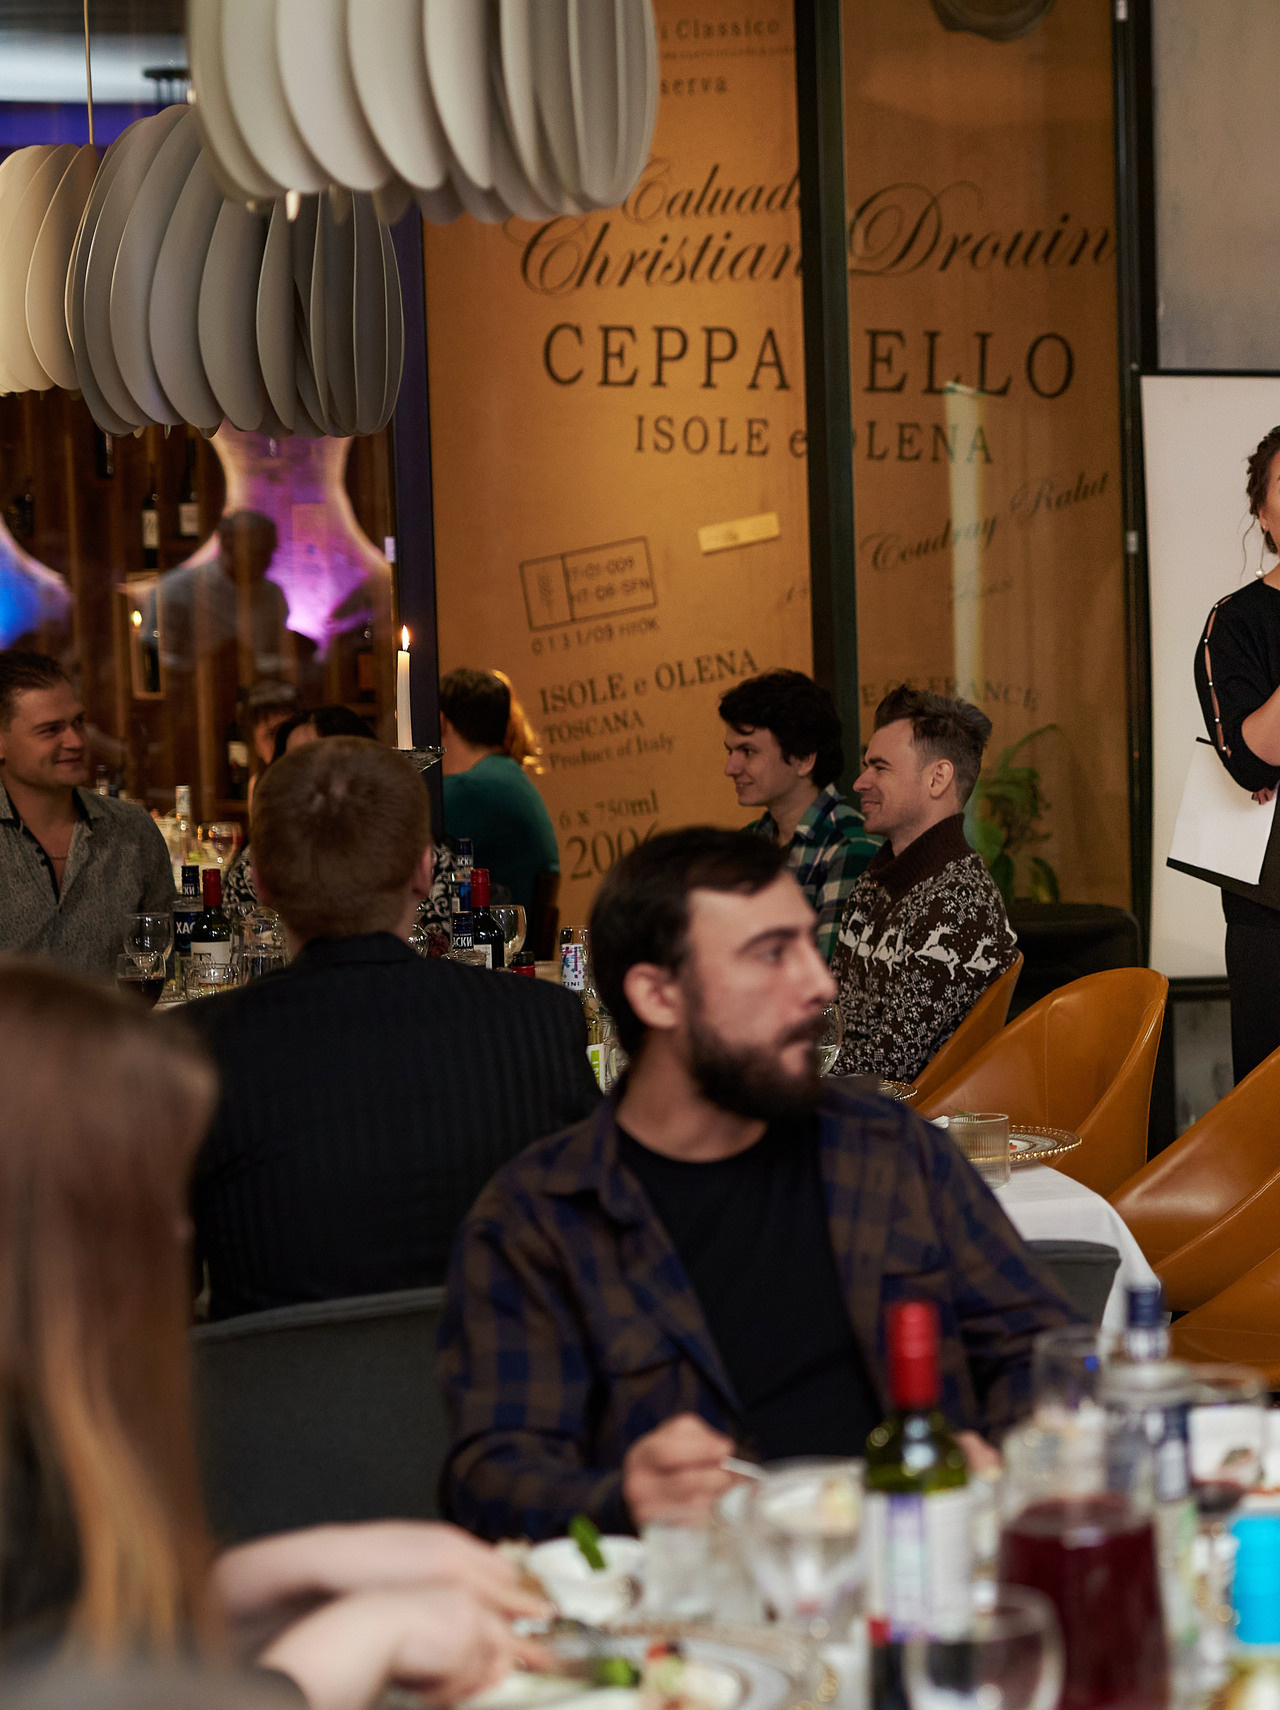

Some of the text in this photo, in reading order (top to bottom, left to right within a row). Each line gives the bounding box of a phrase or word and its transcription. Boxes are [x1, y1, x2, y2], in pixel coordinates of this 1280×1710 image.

[660, 75, 728, 96] serva
[503, 180, 1114, 295] Christian Drouin
[543, 322, 1076, 400] CEPPAELLO
[634, 414, 771, 458] ISOLE
[850, 420, 994, 464] LENA
[539, 648, 759, 715] ISOLE e OLENA
[543, 709, 645, 745] TOSCANA
[549, 746, 613, 771] Product
[636, 731, 675, 755] Italy
